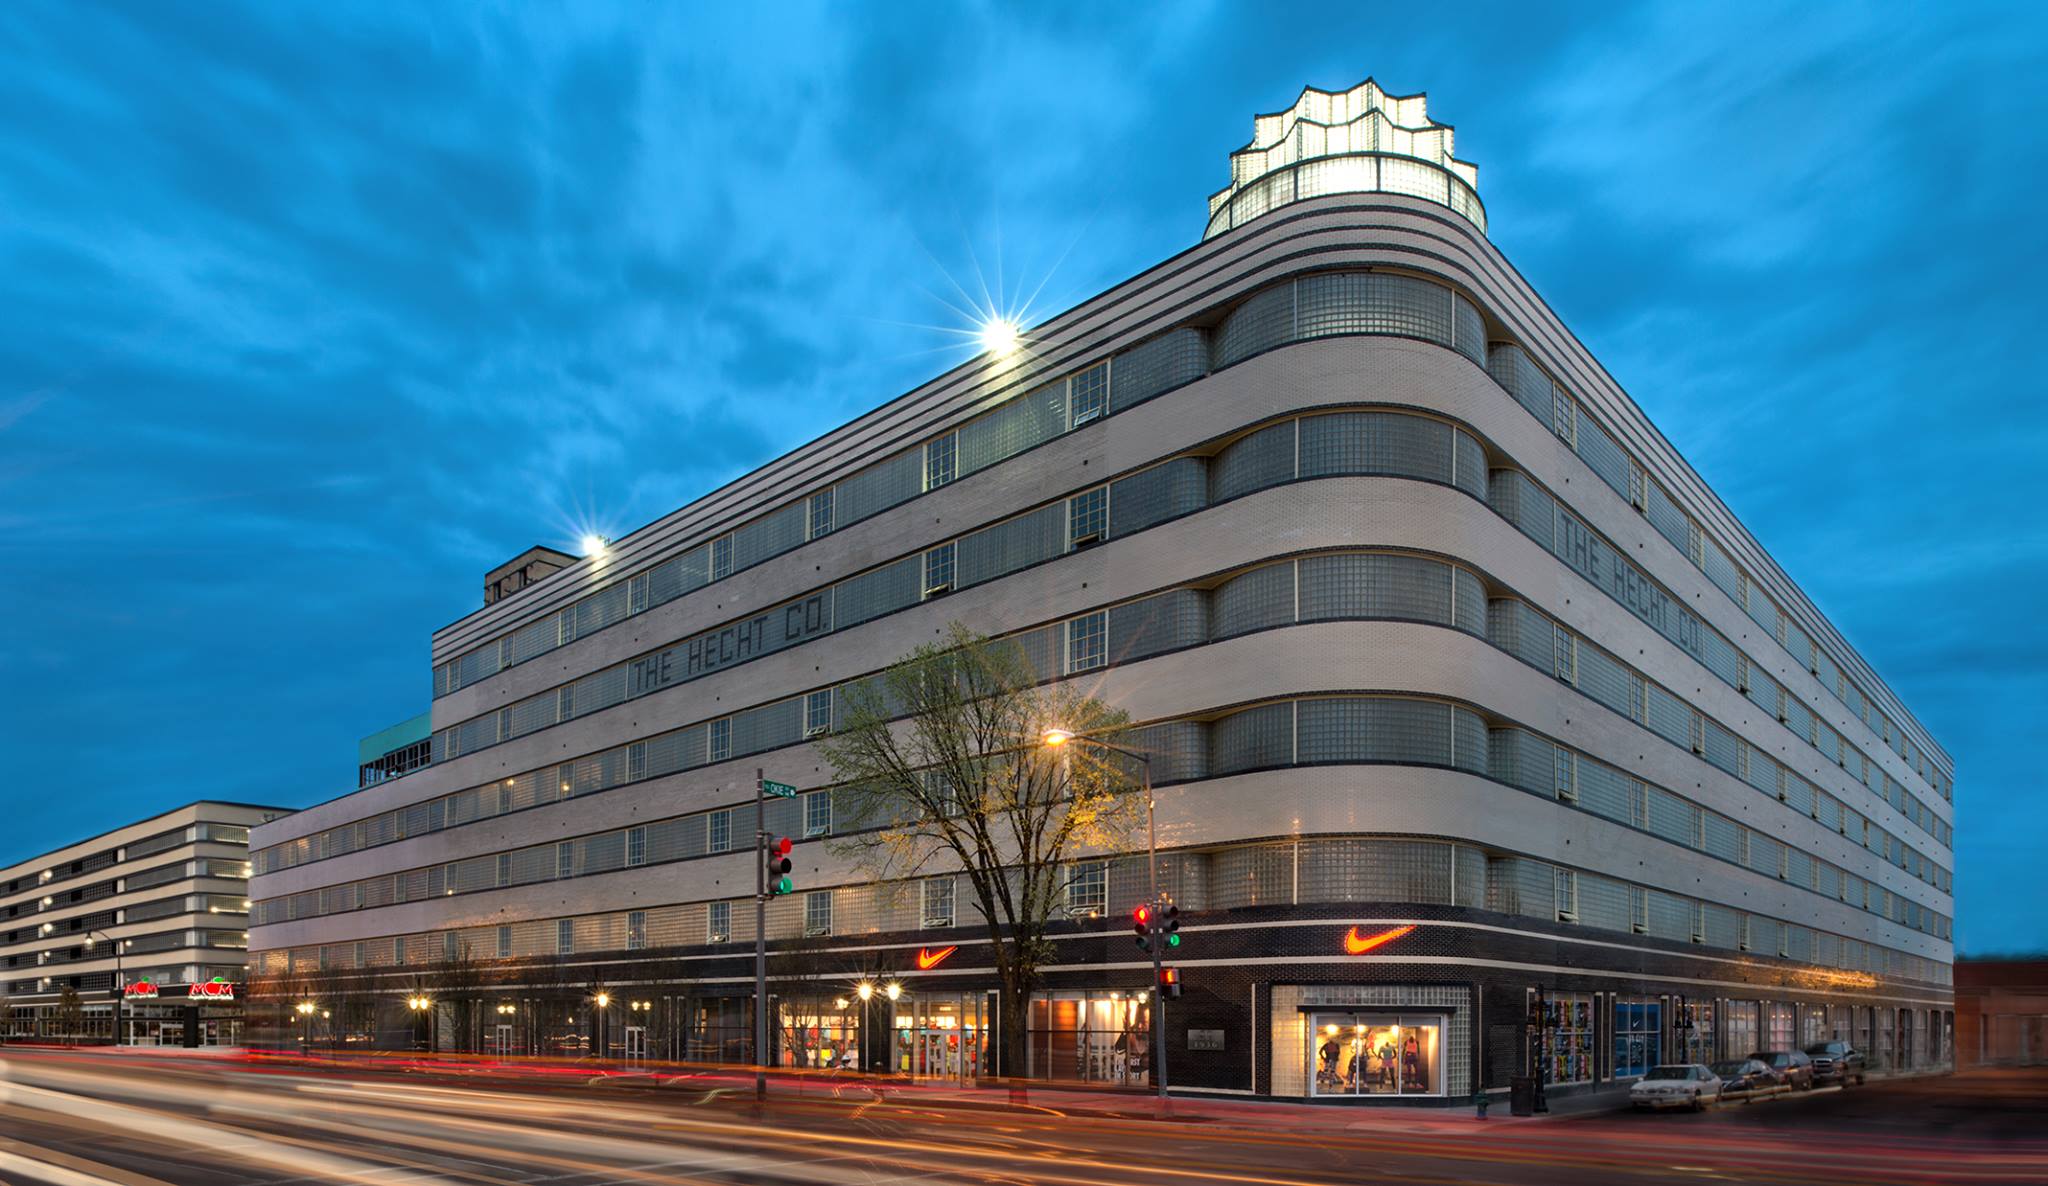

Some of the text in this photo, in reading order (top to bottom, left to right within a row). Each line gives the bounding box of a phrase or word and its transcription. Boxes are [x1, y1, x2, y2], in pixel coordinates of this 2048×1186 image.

[1561, 513, 1599, 580] THE
[1614, 555, 1669, 631] HECHT
[634, 596, 827, 692] THE HECHT CO.
